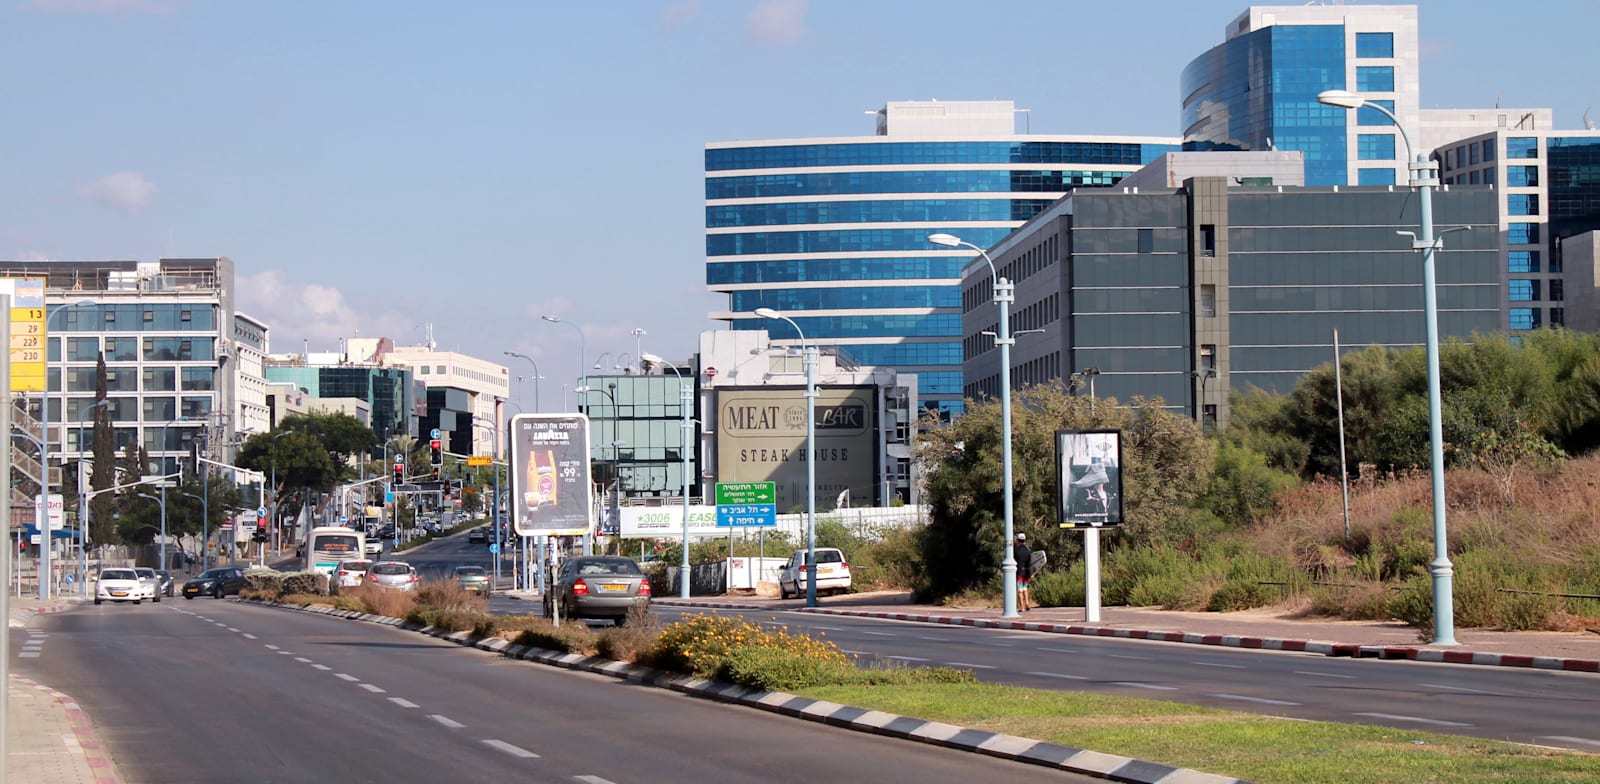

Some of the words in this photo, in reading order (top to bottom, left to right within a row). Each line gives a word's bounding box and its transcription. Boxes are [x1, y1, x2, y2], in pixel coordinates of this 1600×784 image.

[29, 310, 42, 319] 13
[28, 325, 38, 333] 29
[23, 338, 38, 347] 229
[23, 352, 38, 360] 230
[728, 406, 779, 430] MEAT
[815, 407, 858, 428] BAR
[533, 429, 569, 440] LAVAZZA
[741, 449, 789, 462] STEAK
[799, 448, 848, 462] HUSE
[682, 512, 717, 522] EASE
[736, 517, 756, 525] חיפה
